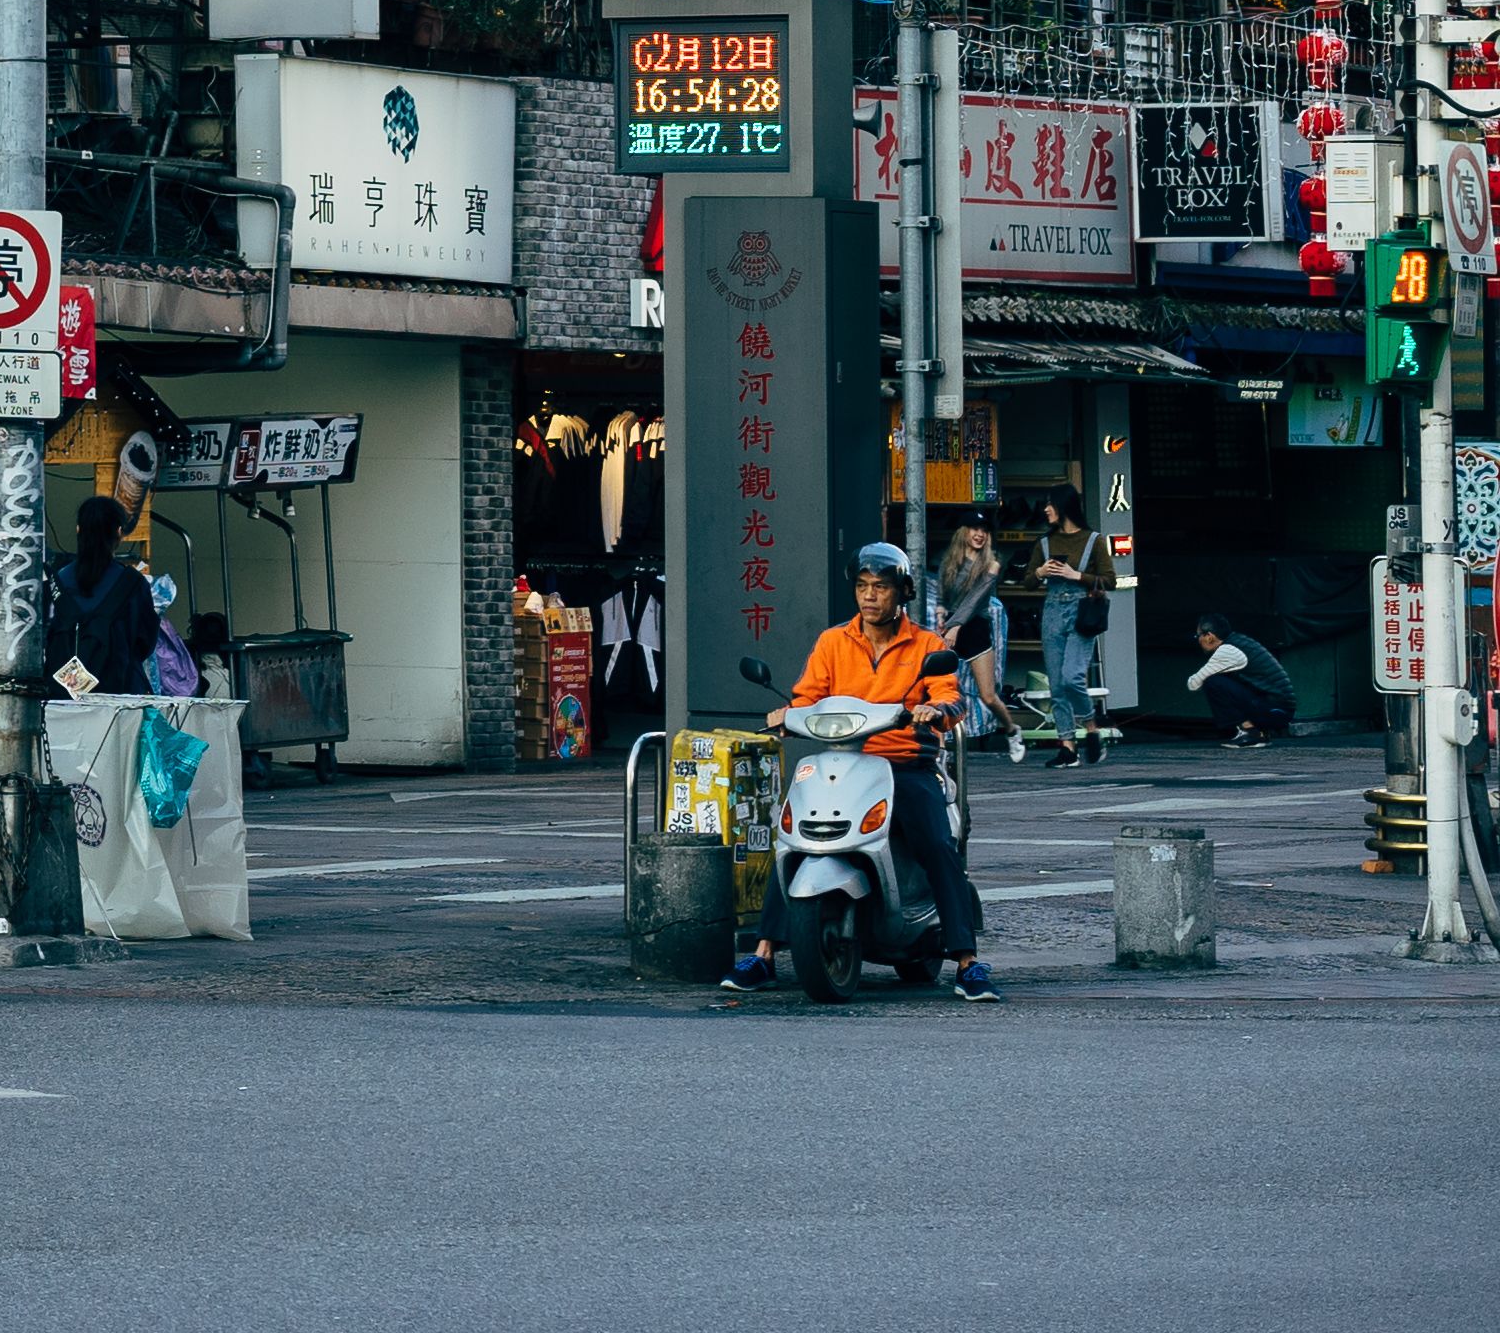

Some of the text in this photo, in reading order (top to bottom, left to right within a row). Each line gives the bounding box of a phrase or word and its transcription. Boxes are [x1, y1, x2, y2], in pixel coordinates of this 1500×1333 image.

[633, 78, 781, 114] 16:54:28
[1151, 165, 1248, 186] TRAVEL
[308, 172, 489, 237] 瑞亨珠寶
[1176, 188, 1226, 209] FOX
[1455, 169, 1480, 226] 停
[310, 236, 489, 263] RAHEN JEWELRY
[1008, 224, 1114, 256] TRAVEL FOX
[1472, 256, 1487, 272] 110
[725, 293, 756, 312] STREET
[9, 404, 34, 415] ZONE
[262, 427, 321, 463] 炸鮮奶
[735, 321, 778, 641] 饒河街觀光夜市
[1390, 507, 1406, 520] JS
[1388, 520, 1409, 530] ONE
[671, 811, 693, 824] JS
[747, 828, 769, 848] 003
